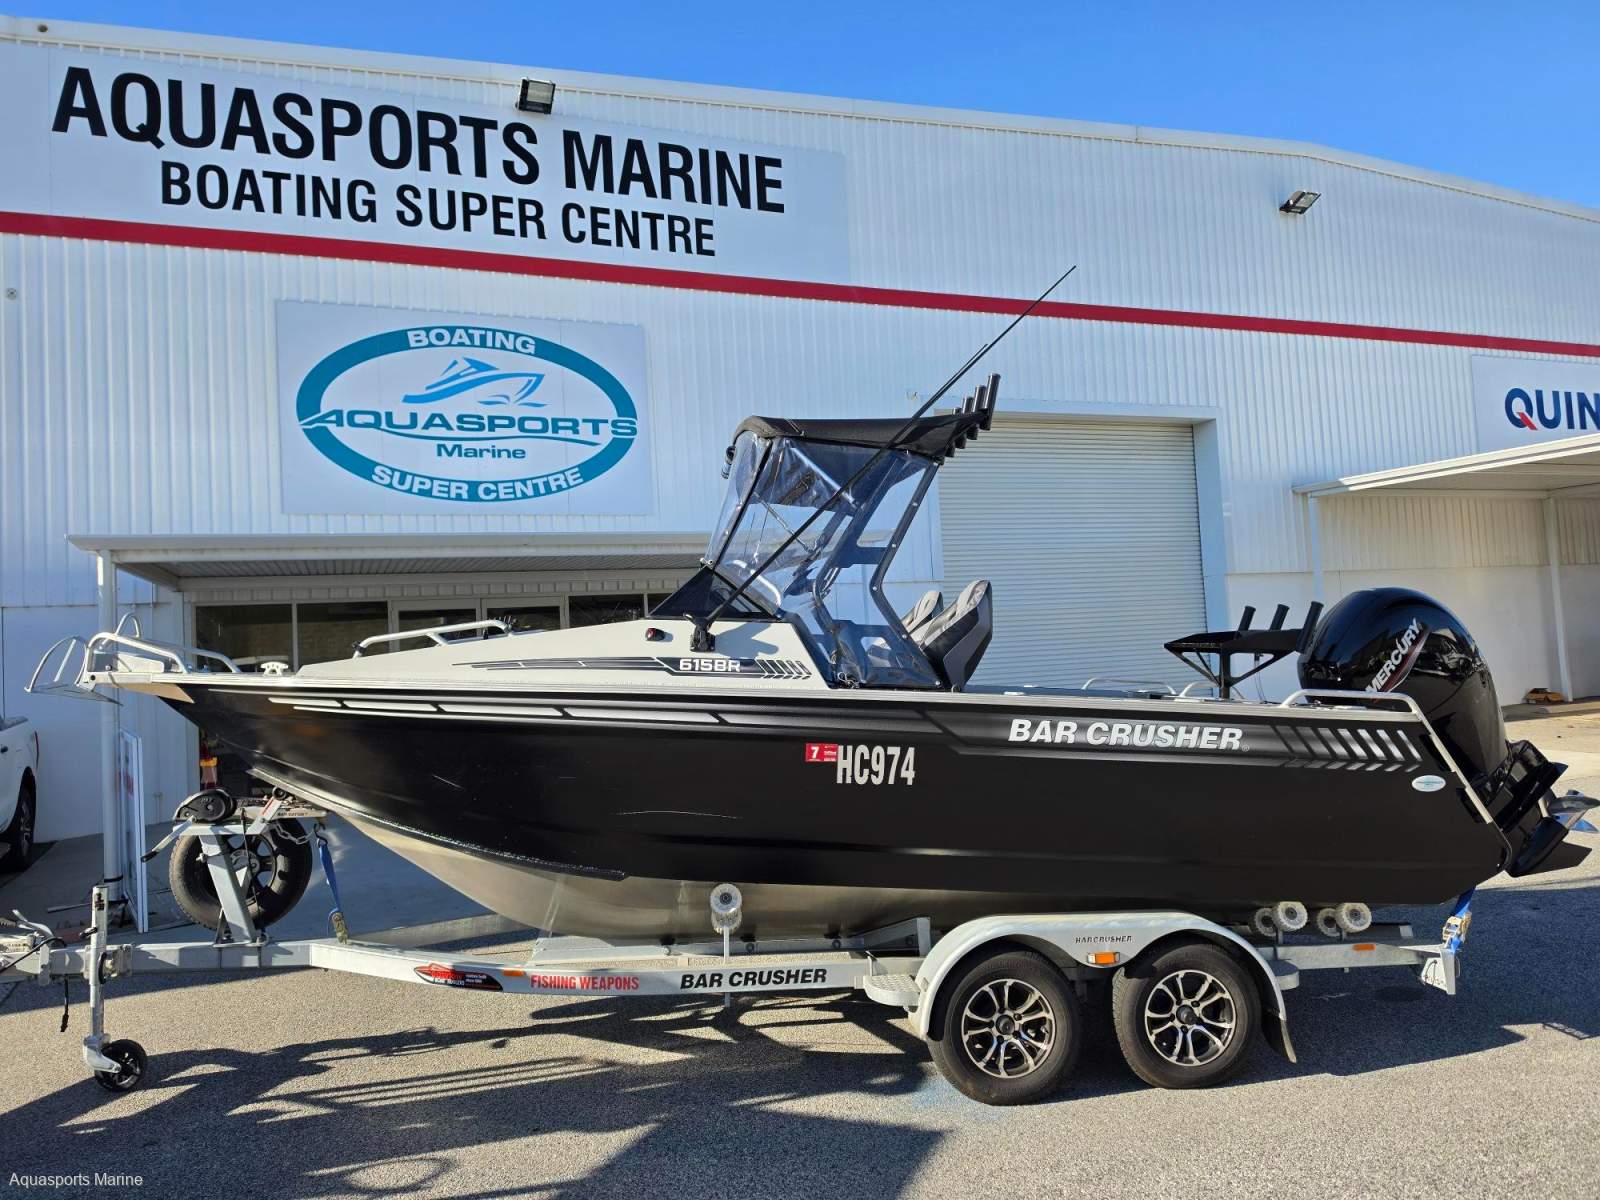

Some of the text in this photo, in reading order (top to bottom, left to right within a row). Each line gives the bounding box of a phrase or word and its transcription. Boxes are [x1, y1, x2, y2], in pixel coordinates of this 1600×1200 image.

[52, 66, 785, 214] AQUASPORTS MARINE
[161, 160, 716, 257] BOATING SUPER CENTRE
[406, 328, 537, 354] BOATING
[300, 408, 638, 438] AQUASPORTS
[436, 443, 526, 459] Marine
[371, 465, 584, 500] SUPER CENTRE
[1365, 617, 1420, 692] MERCURY
[1008, 718, 1244, 751] BAR CRUSHER
[810, 746, 820, 759] 7
[836, 744, 916, 786] HC974
[530, 974, 640, 991] FISHING WEAPONS
[680, 968, 828, 990] BAR CRUSHER
